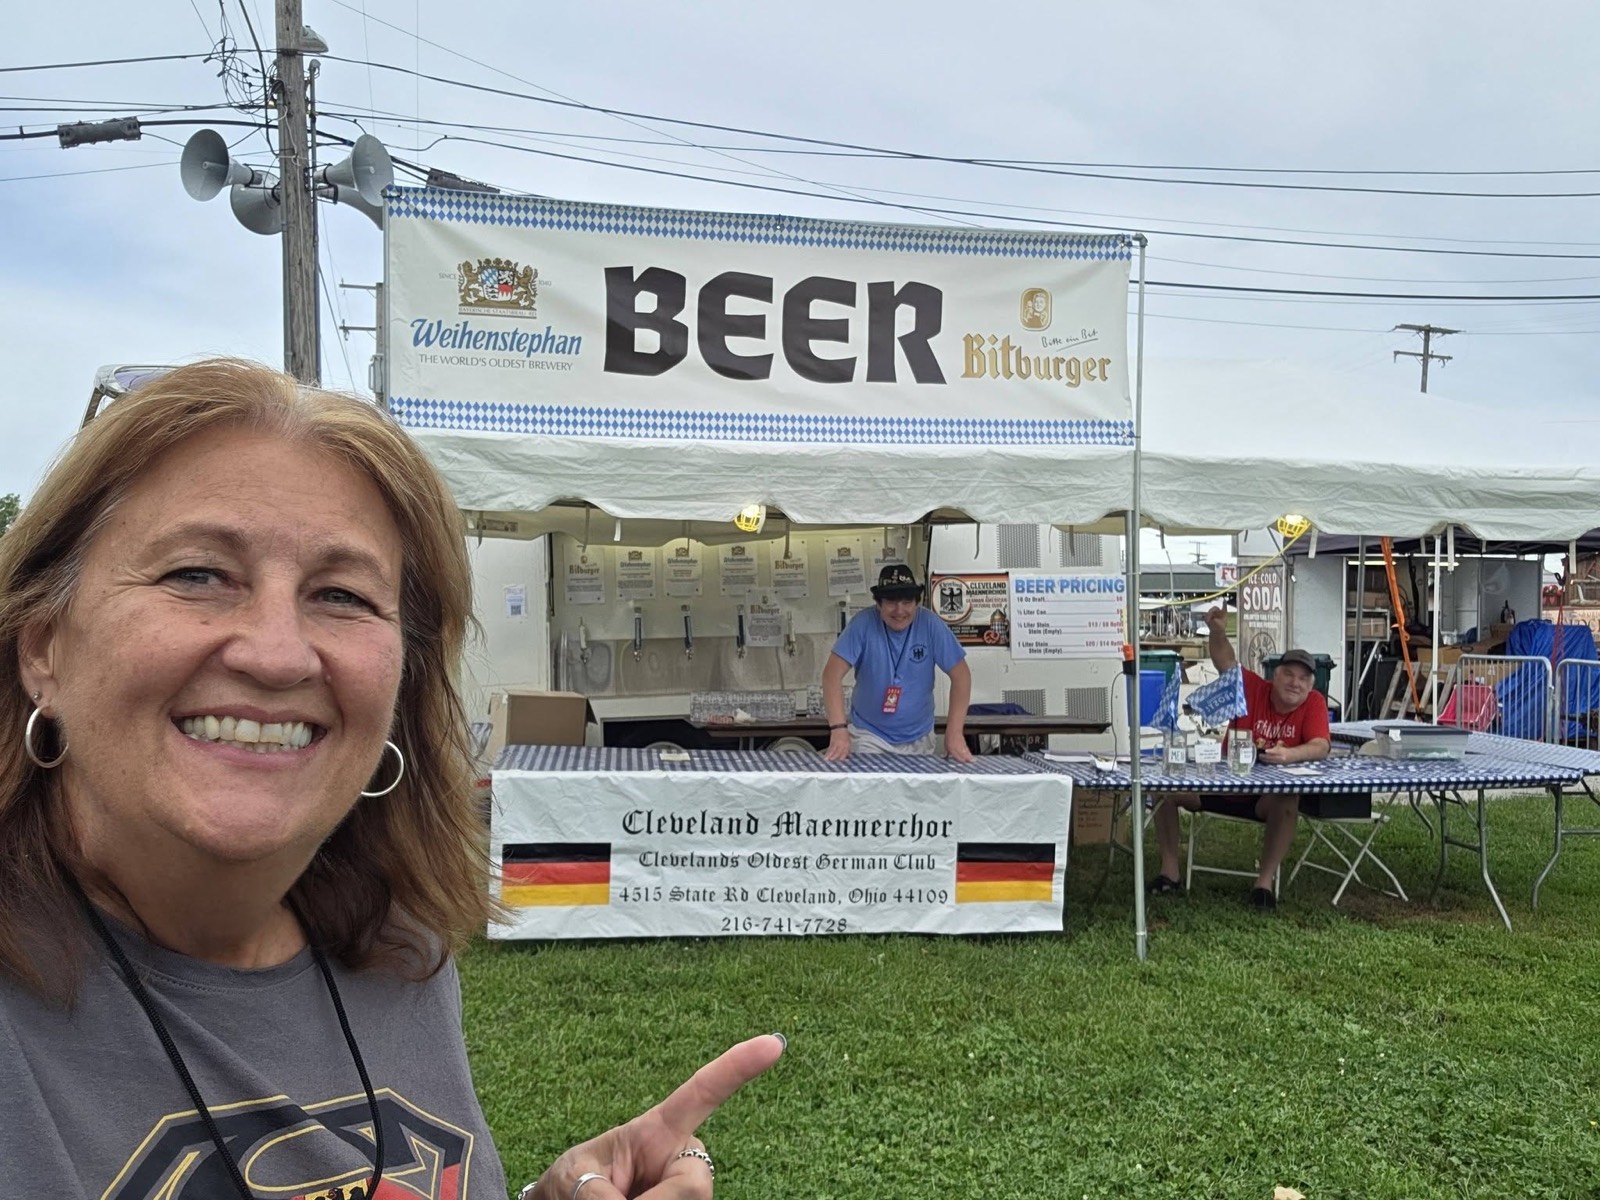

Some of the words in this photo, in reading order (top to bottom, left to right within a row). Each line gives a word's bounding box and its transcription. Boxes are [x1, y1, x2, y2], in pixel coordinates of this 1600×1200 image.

[604, 266, 947, 384] BEER
[1081, 328, 1098, 340] Bit
[410, 318, 582, 358] Weihenstephan
[419, 354, 438, 364] THE
[440, 355, 487, 367] WORLD'S
[488, 358, 526, 369] OLDEST
[528, 360, 573, 371] BREWERY
[960, 333, 1112, 388] Bitburger
[1015, 578, 1056, 593] BEER
[1060, 578, 1125, 593] PRICING
[1243, 586, 1283, 611] SODA
[622, 809, 759, 835] Cleveland
[770, 811, 952, 842] Maennerchor
[748, 852, 808, 869] Oldest
[816, 854, 888, 870] German
[894, 854, 936, 870] Club
[619, 886, 662, 902] 4515
[669, 886, 716, 902] State
[723, 886, 749, 902] Rd
[756, 887, 842, 905] Cleveland,
[849, 888, 887, 906] Ohio
[893, 888, 948, 904] 44109
[721, 917, 847, 932] 216-741-7728
